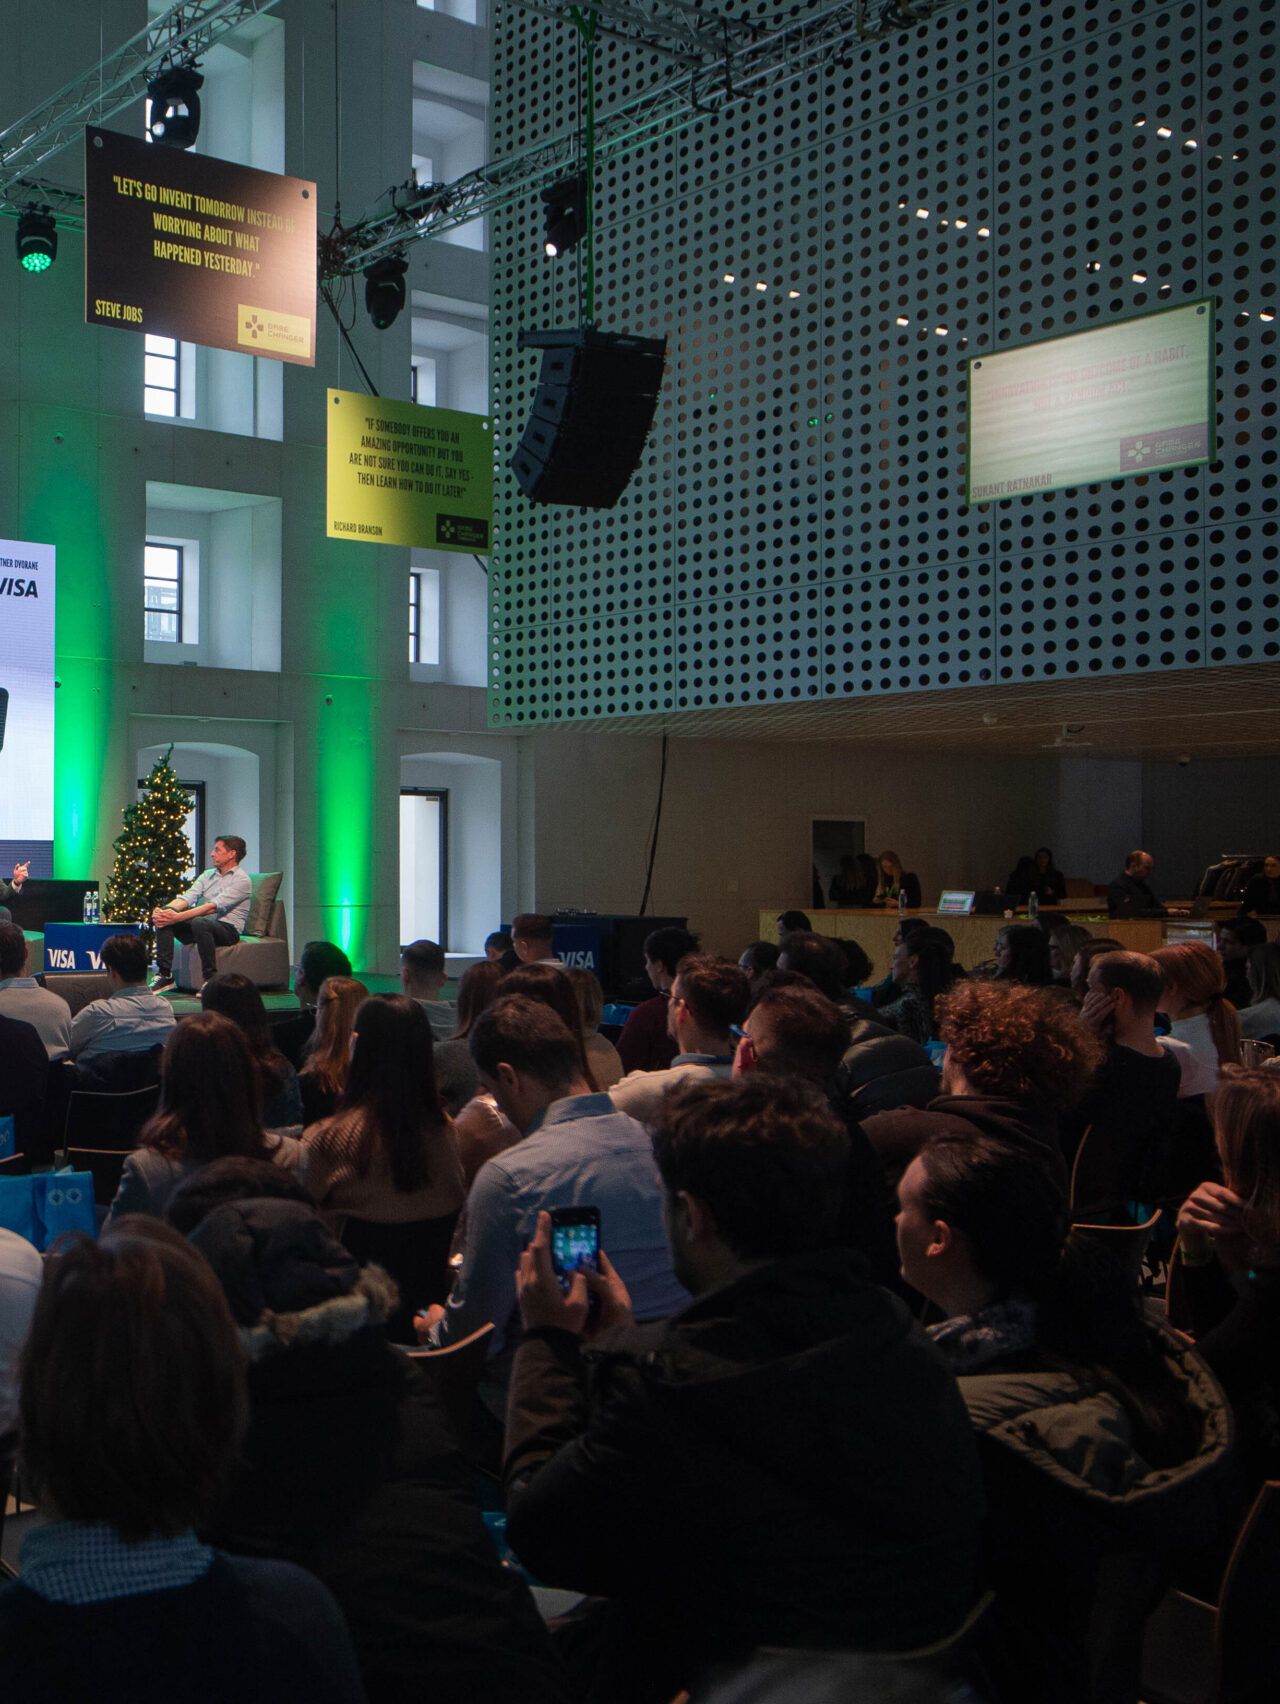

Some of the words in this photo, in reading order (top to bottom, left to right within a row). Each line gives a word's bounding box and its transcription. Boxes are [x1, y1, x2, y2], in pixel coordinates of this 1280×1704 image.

[113, 175, 143, 199] "LET'S
[144, 185, 158, 202] GO
[159, 187, 193, 211] INVENT
[194, 194, 245, 223] TOMORROW
[247, 208, 284, 231] INSTEAD
[153, 212, 202, 240] WORRYING
[204, 226, 233, 246] ABOUT
[234, 231, 261, 253] WHAT
[153, 239, 202, 266] HAPPENED
[203, 251, 261, 279] YESTERDAY."
[95, 299, 121, 319] STEVE
[122, 306, 144, 324] JOBS
[376, 419, 411, 436] SOMEBODY
[412, 425, 436, 440] OFFERS
[437, 429, 450, 443] YOU
[361, 435, 392, 452] AMAZING
[392, 440, 436, 459] OPPORTUNITY
[437, 446, 450, 460] BUT
[451, 449, 464, 463] YOU
[349, 452, 362, 466] ARE
[363, 454, 378, 468] NOT
[378, 456, 396, 471] SURE
[396, 459, 410, 473] YOU
[444, 467, 458, 480] SAY
[458, 469, 470, 482] YES
[357, 472, 375, 486] THEN
[376, 473, 398, 489] LEARN
[398, 477, 414, 492] HOW
[414, 480, 424, 493] TO
[333, 521, 357, 534] RICHARD
[358, 523, 383, 536] BRANSON
[14, 559, 39, 571] DVORANE
[47, 948, 76, 970] VISA
[556, 951, 595, 969] VISA
